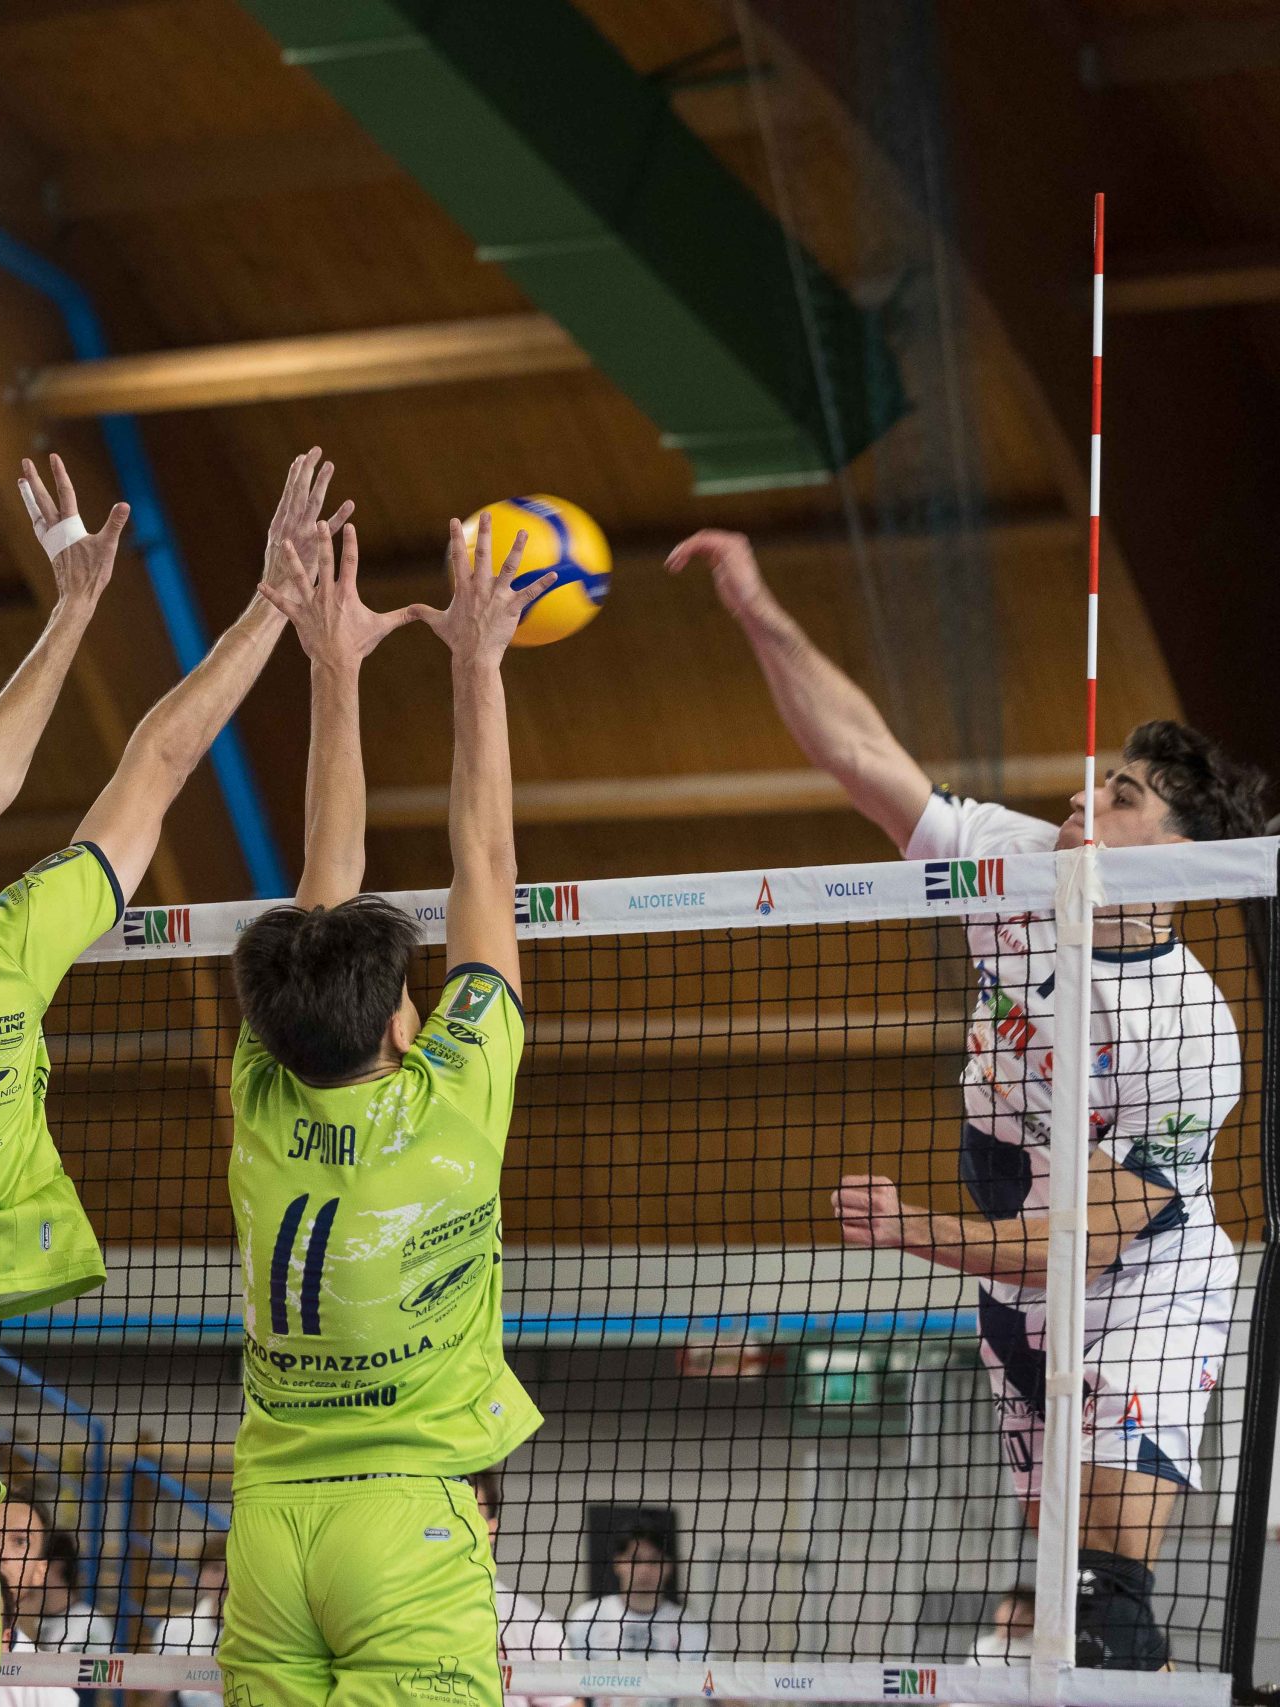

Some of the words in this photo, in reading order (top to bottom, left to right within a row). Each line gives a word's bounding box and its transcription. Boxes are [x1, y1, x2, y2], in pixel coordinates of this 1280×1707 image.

[628, 891, 706, 910] ALTOTEVERE
[825, 880, 874, 897] VOLLEY
[415, 907, 446, 921] VOLL
[426, 1041, 464, 1069] CANEPA
[288, 1118, 356, 1166] SPINA
[419, 1225, 465, 1249] COLD
[421, 1211, 472, 1238] ARREDO
[270, 1193, 340, 1335] 11
[415, 1263, 486, 1318] MECCANICA
[300, 1336, 434, 1372] PIAZZOLLA
[279, 1376, 289, 1386] la
[293, 1378, 337, 1388] certezza
[341, 1379, 352, 1388] di
[185, 1669, 221, 1681] ALTOTE
[579, 1675, 642, 1688] ALTOTEVERE
[773, 1677, 814, 1690] VOLLEY
